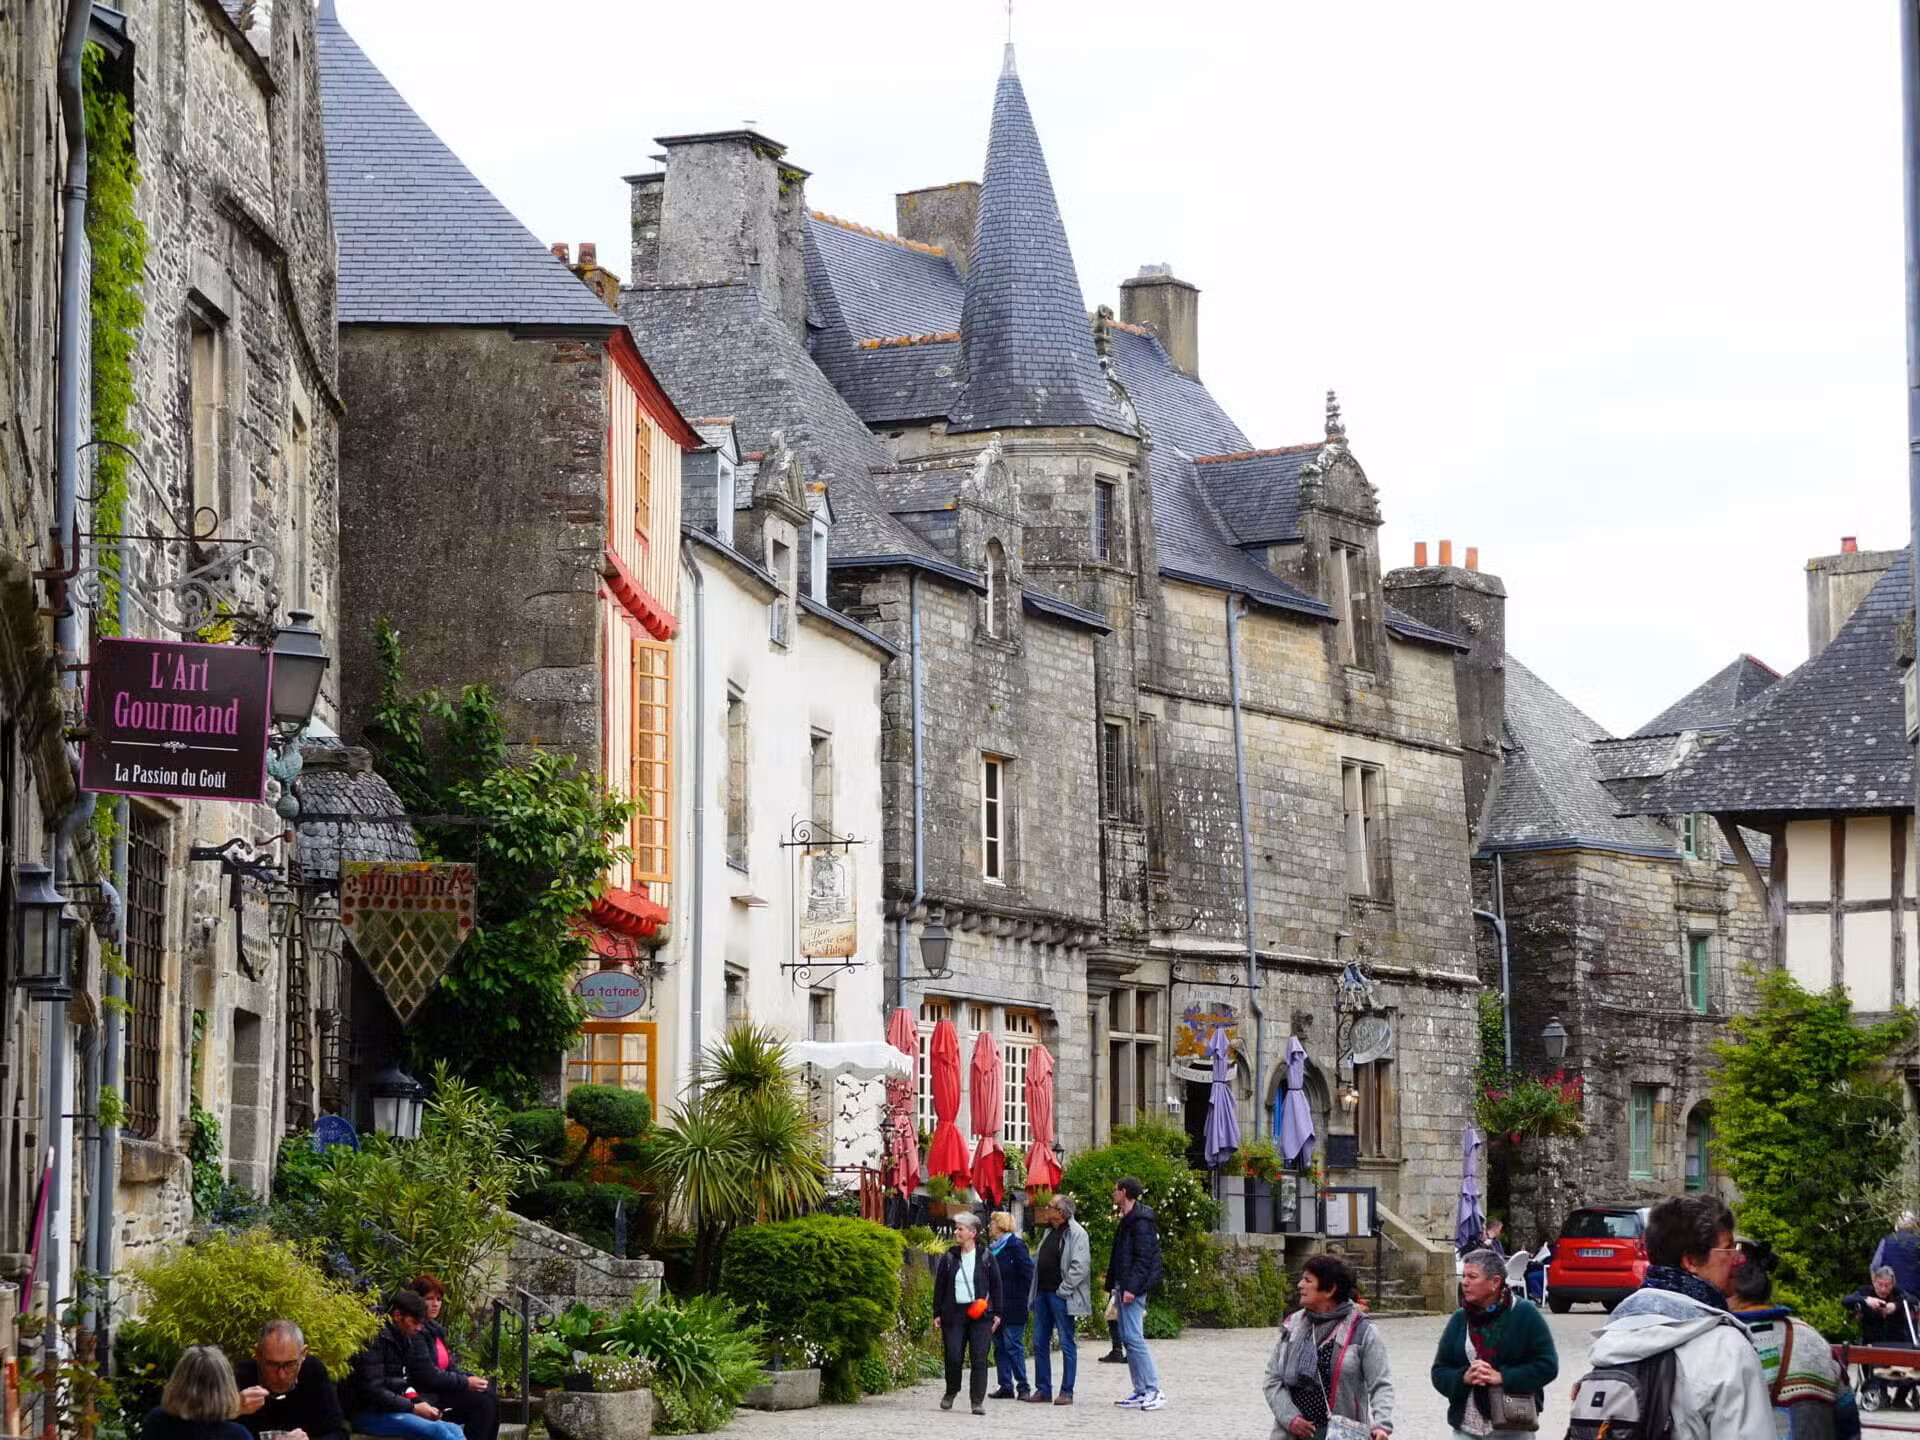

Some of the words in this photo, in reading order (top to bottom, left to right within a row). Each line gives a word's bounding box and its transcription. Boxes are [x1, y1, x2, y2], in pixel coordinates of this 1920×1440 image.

[150, 652, 209, 692] L'Art
[114, 690, 240, 735] Gourmand
[114, 763, 129, 782] La
[133, 764, 178, 786] Passion
[181, 767, 197, 787] du
[200, 769, 226, 788] Goût
[580, 982, 595, 997] La
[599, 986, 640, 997] tatane
